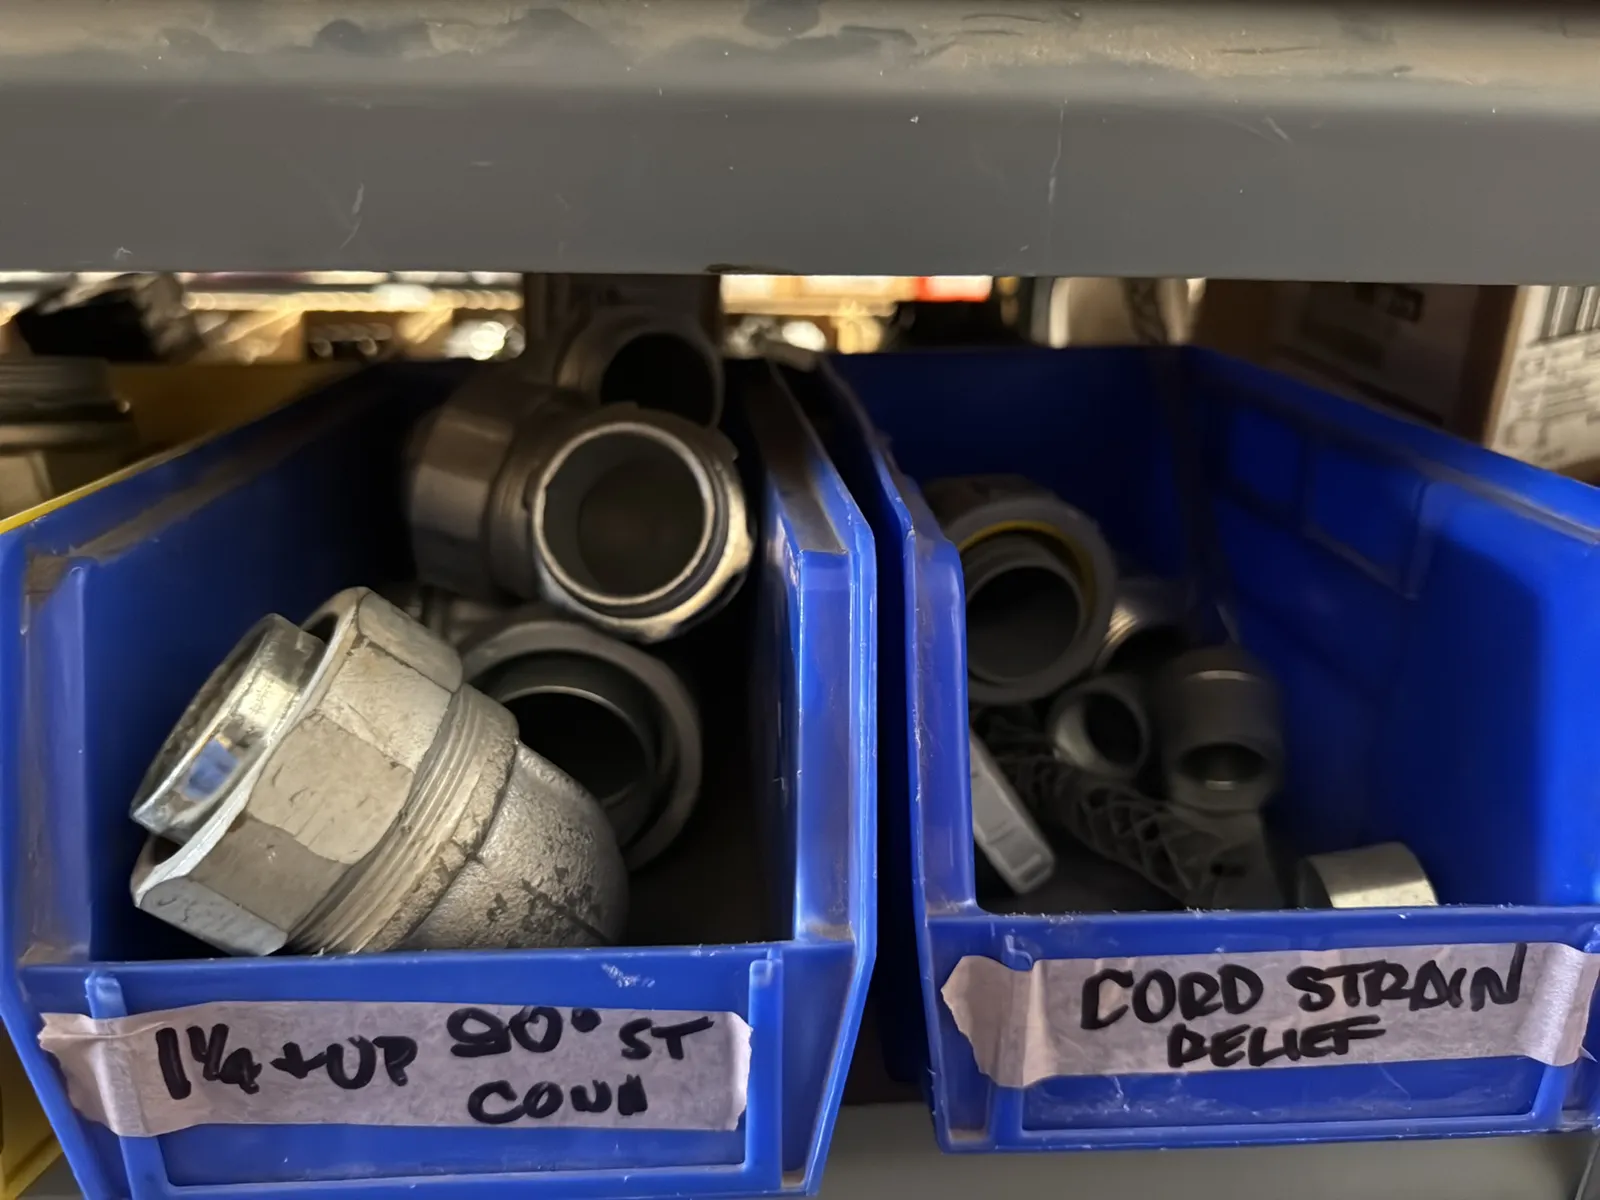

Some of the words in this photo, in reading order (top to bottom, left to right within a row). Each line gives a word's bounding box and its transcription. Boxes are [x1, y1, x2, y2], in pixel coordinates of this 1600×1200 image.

[1080, 964, 1263, 1030] CORD
[1287, 942, 1527, 1012] STRAIN
[619, 1017, 714, 1060] ST
[1167, 1015, 1386, 1068] RELIEF
